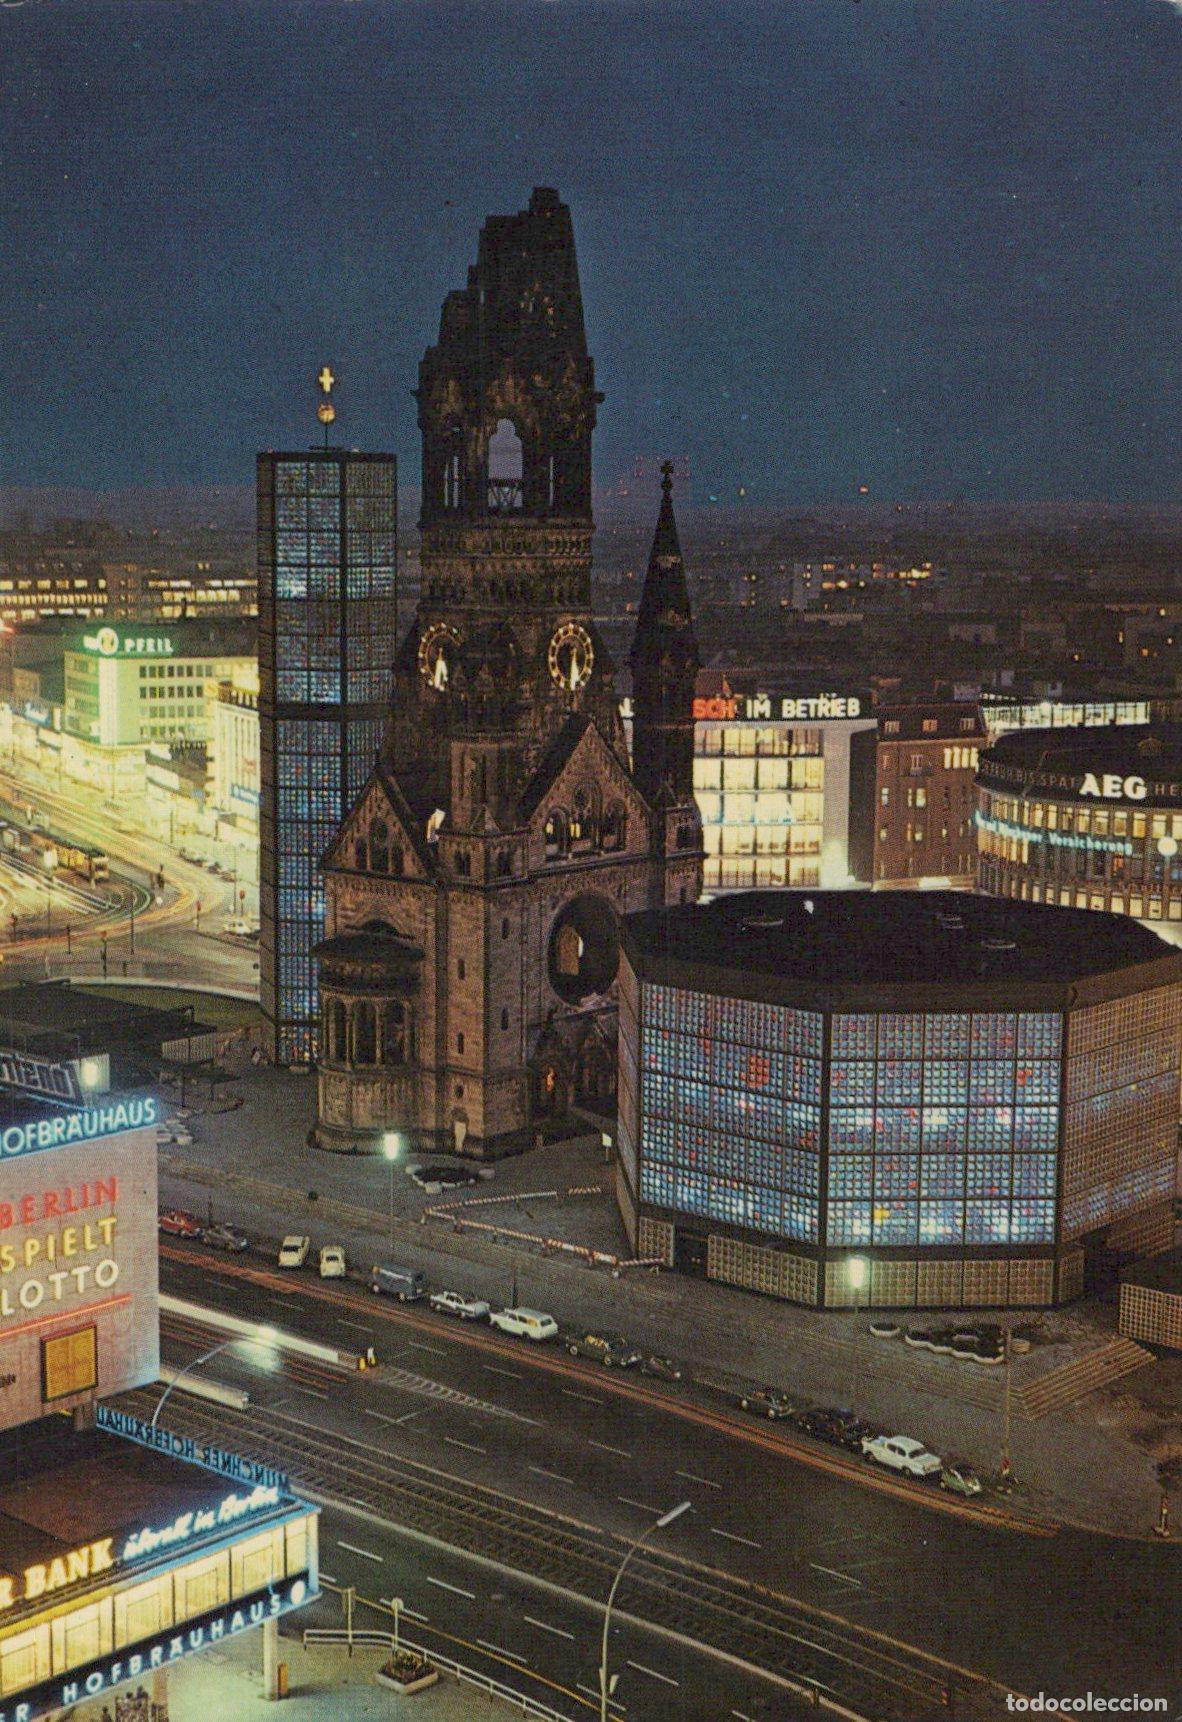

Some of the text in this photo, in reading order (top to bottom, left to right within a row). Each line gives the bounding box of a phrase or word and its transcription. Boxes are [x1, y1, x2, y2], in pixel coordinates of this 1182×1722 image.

[746, 698, 771, 719] IM
[782, 696, 861, 719] BETRIEB
[1079, 773, 1148, 800] AEG
[1049, 831, 1133, 857] Versicherung
[0, 1097, 156, 1153] OFBRÄUHAUS
[0, 1175, 119, 1230] BERLIN
[0, 1216, 117, 1273] SPIELT
[1, 1259, 119, 1316] LOTTO
[24, 1537, 114, 1600] BANK
